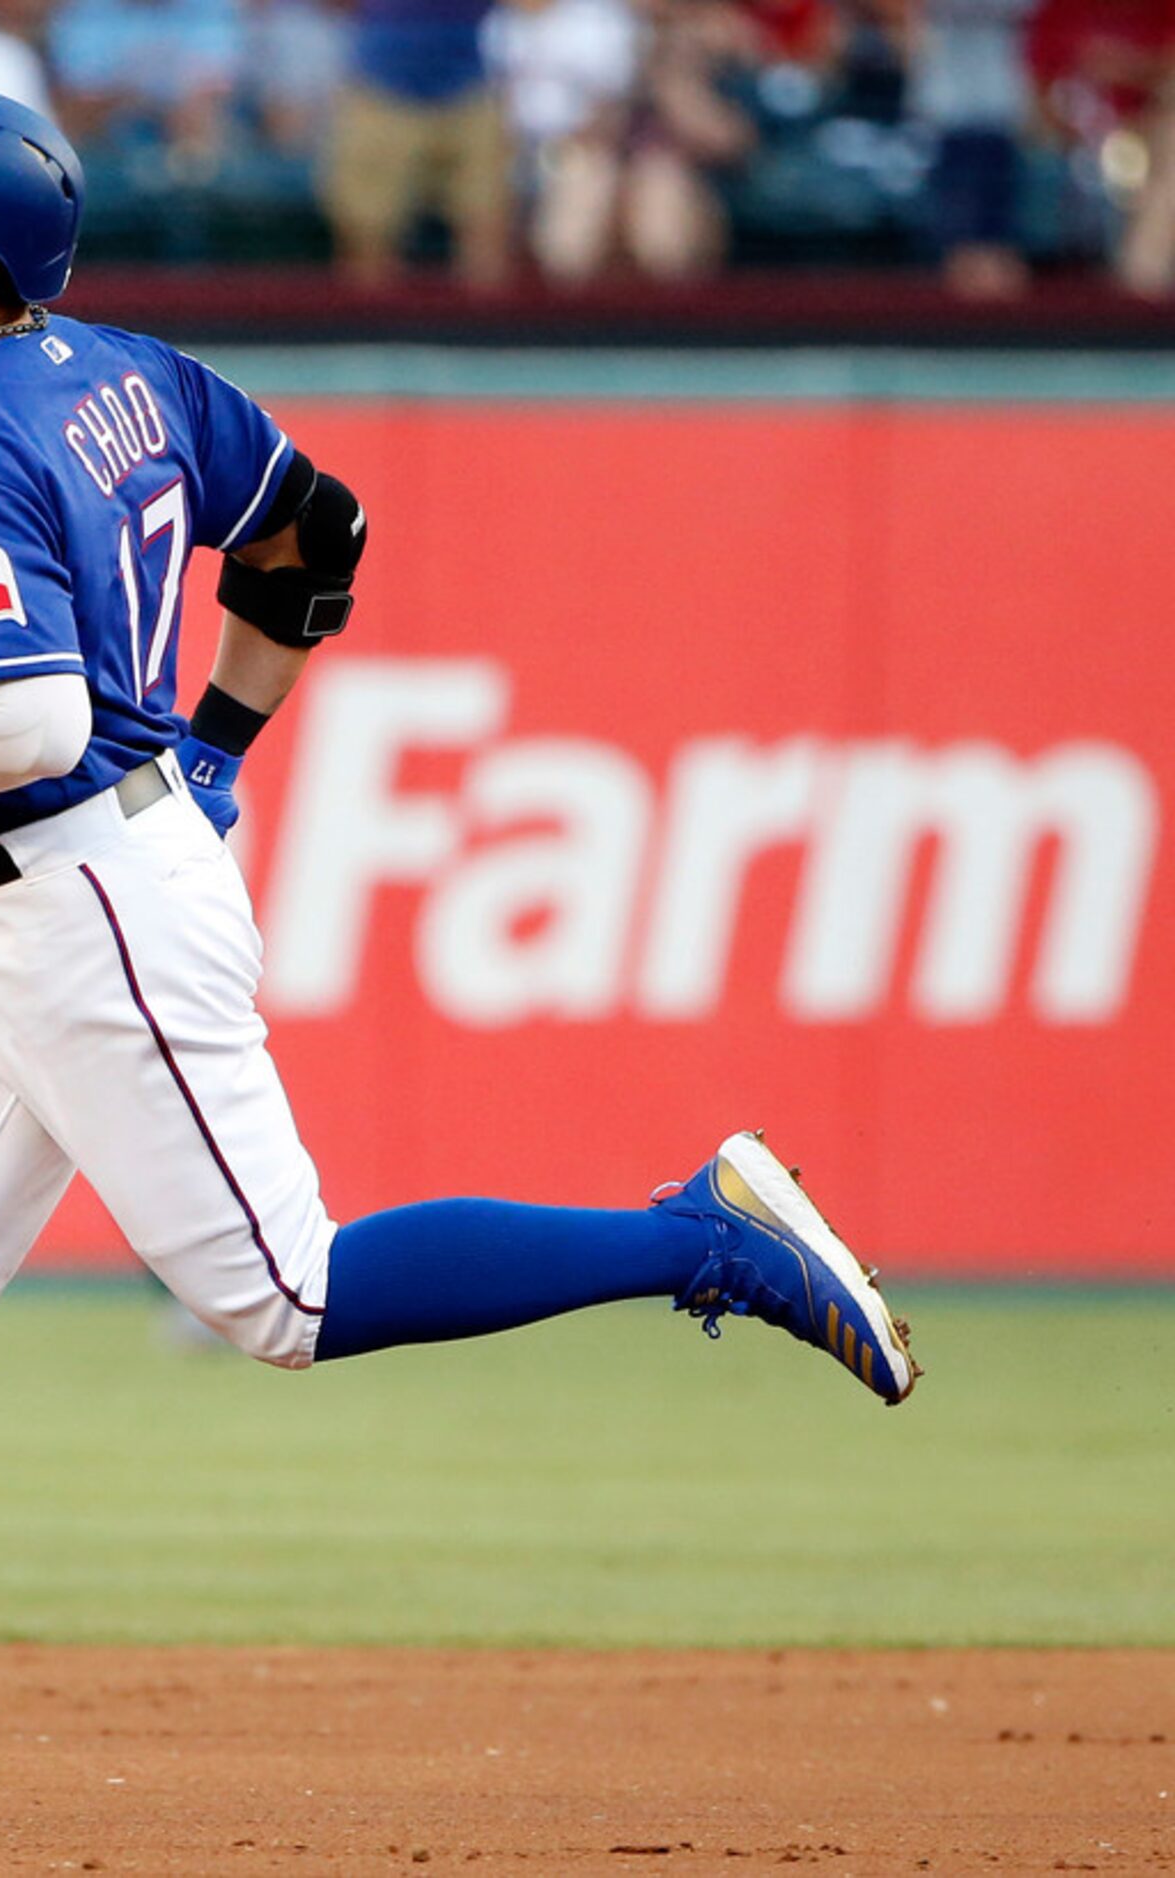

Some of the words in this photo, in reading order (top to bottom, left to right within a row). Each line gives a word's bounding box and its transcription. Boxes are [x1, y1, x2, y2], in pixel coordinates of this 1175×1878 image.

[64, 371, 168, 498] CHOO
[118, 473, 188, 708] 17
[189, 759, 216, 786] 17
[258, 654, 1160, 1029] Farm
